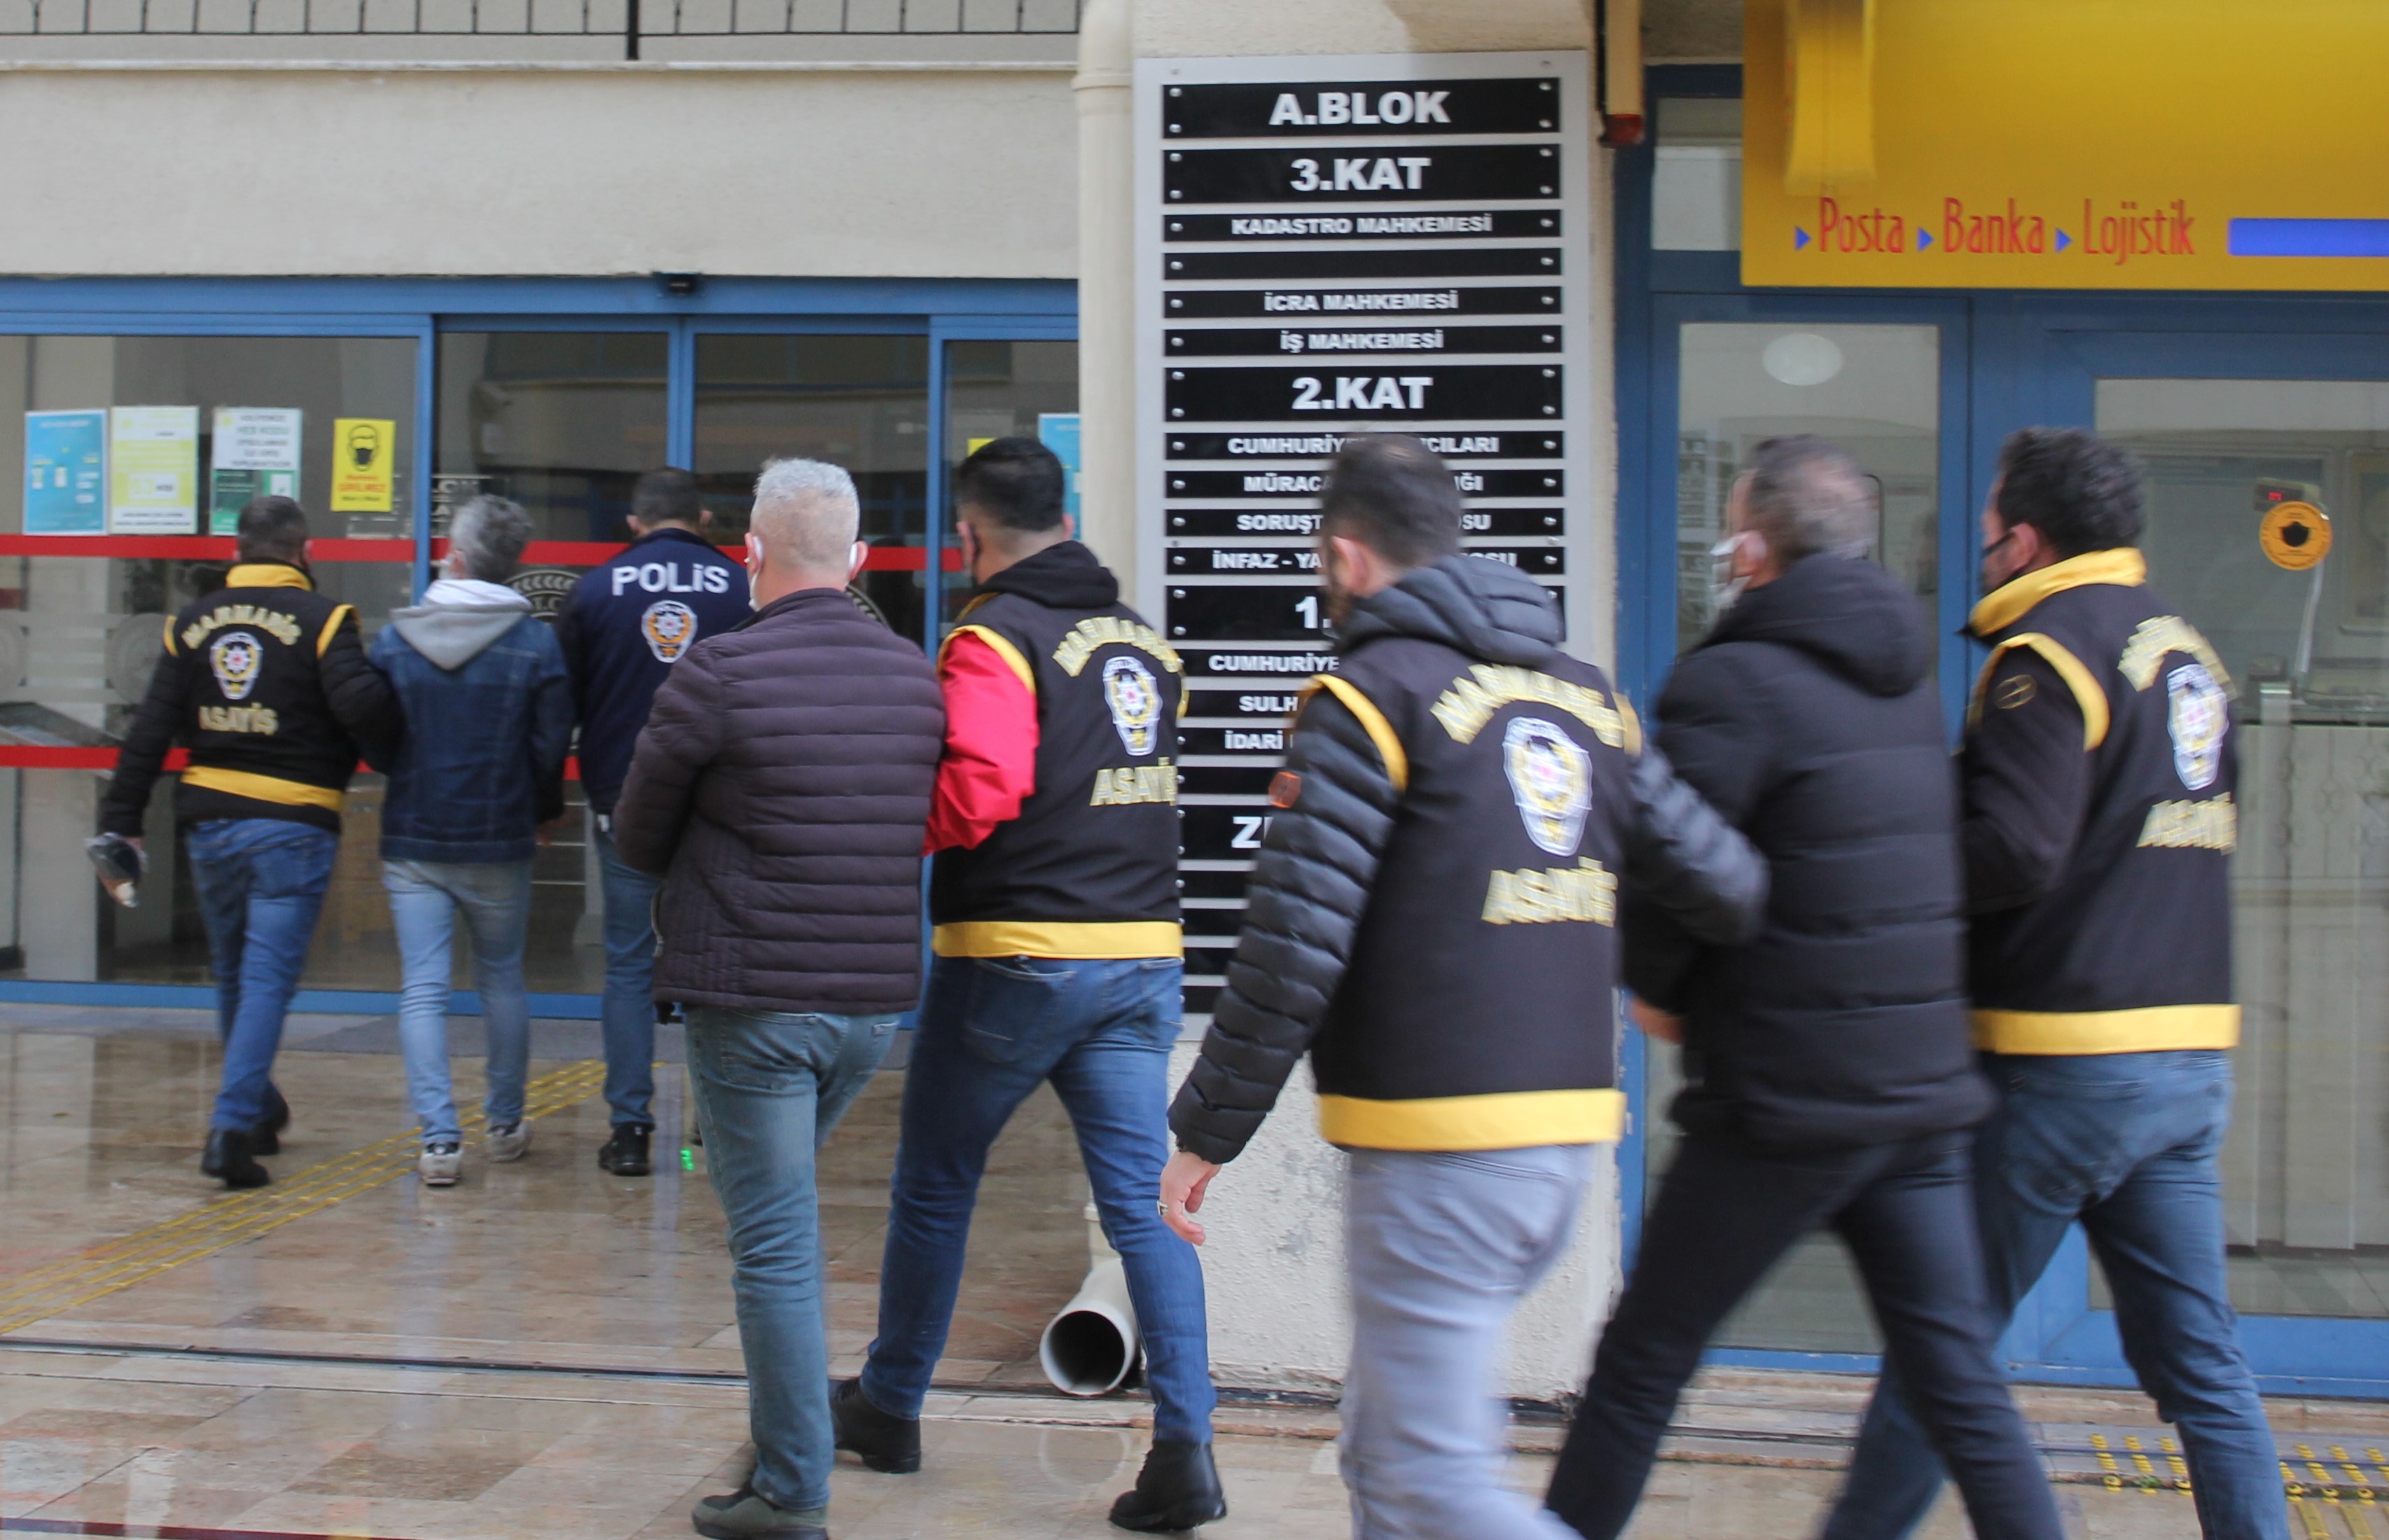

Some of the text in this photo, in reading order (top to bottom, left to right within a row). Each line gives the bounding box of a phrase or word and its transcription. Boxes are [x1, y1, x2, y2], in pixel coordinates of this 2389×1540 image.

[1268, 91, 1450, 125] A.BLOK
[1290, 157, 1431, 192] 3.KAT
[1231, 213, 1492, 235] KADASTRO MAHKEMESİ
[1819, 196, 2196, 265] Posta Banka Lojistik
[1264, 289, 1458, 311] İCRA MAHKEMESİ
[1280, 329, 1443, 353] İŞ MAHKEMESİ
[1292, 376, 1433, 410] 2.KAT
[1227, 434, 1366, 455] CUMHURİY
[1212, 550, 1279, 569] İNFAZ
[1239, 695, 1299, 712] SULH
[1224, 730, 1284, 750] İDARİ
